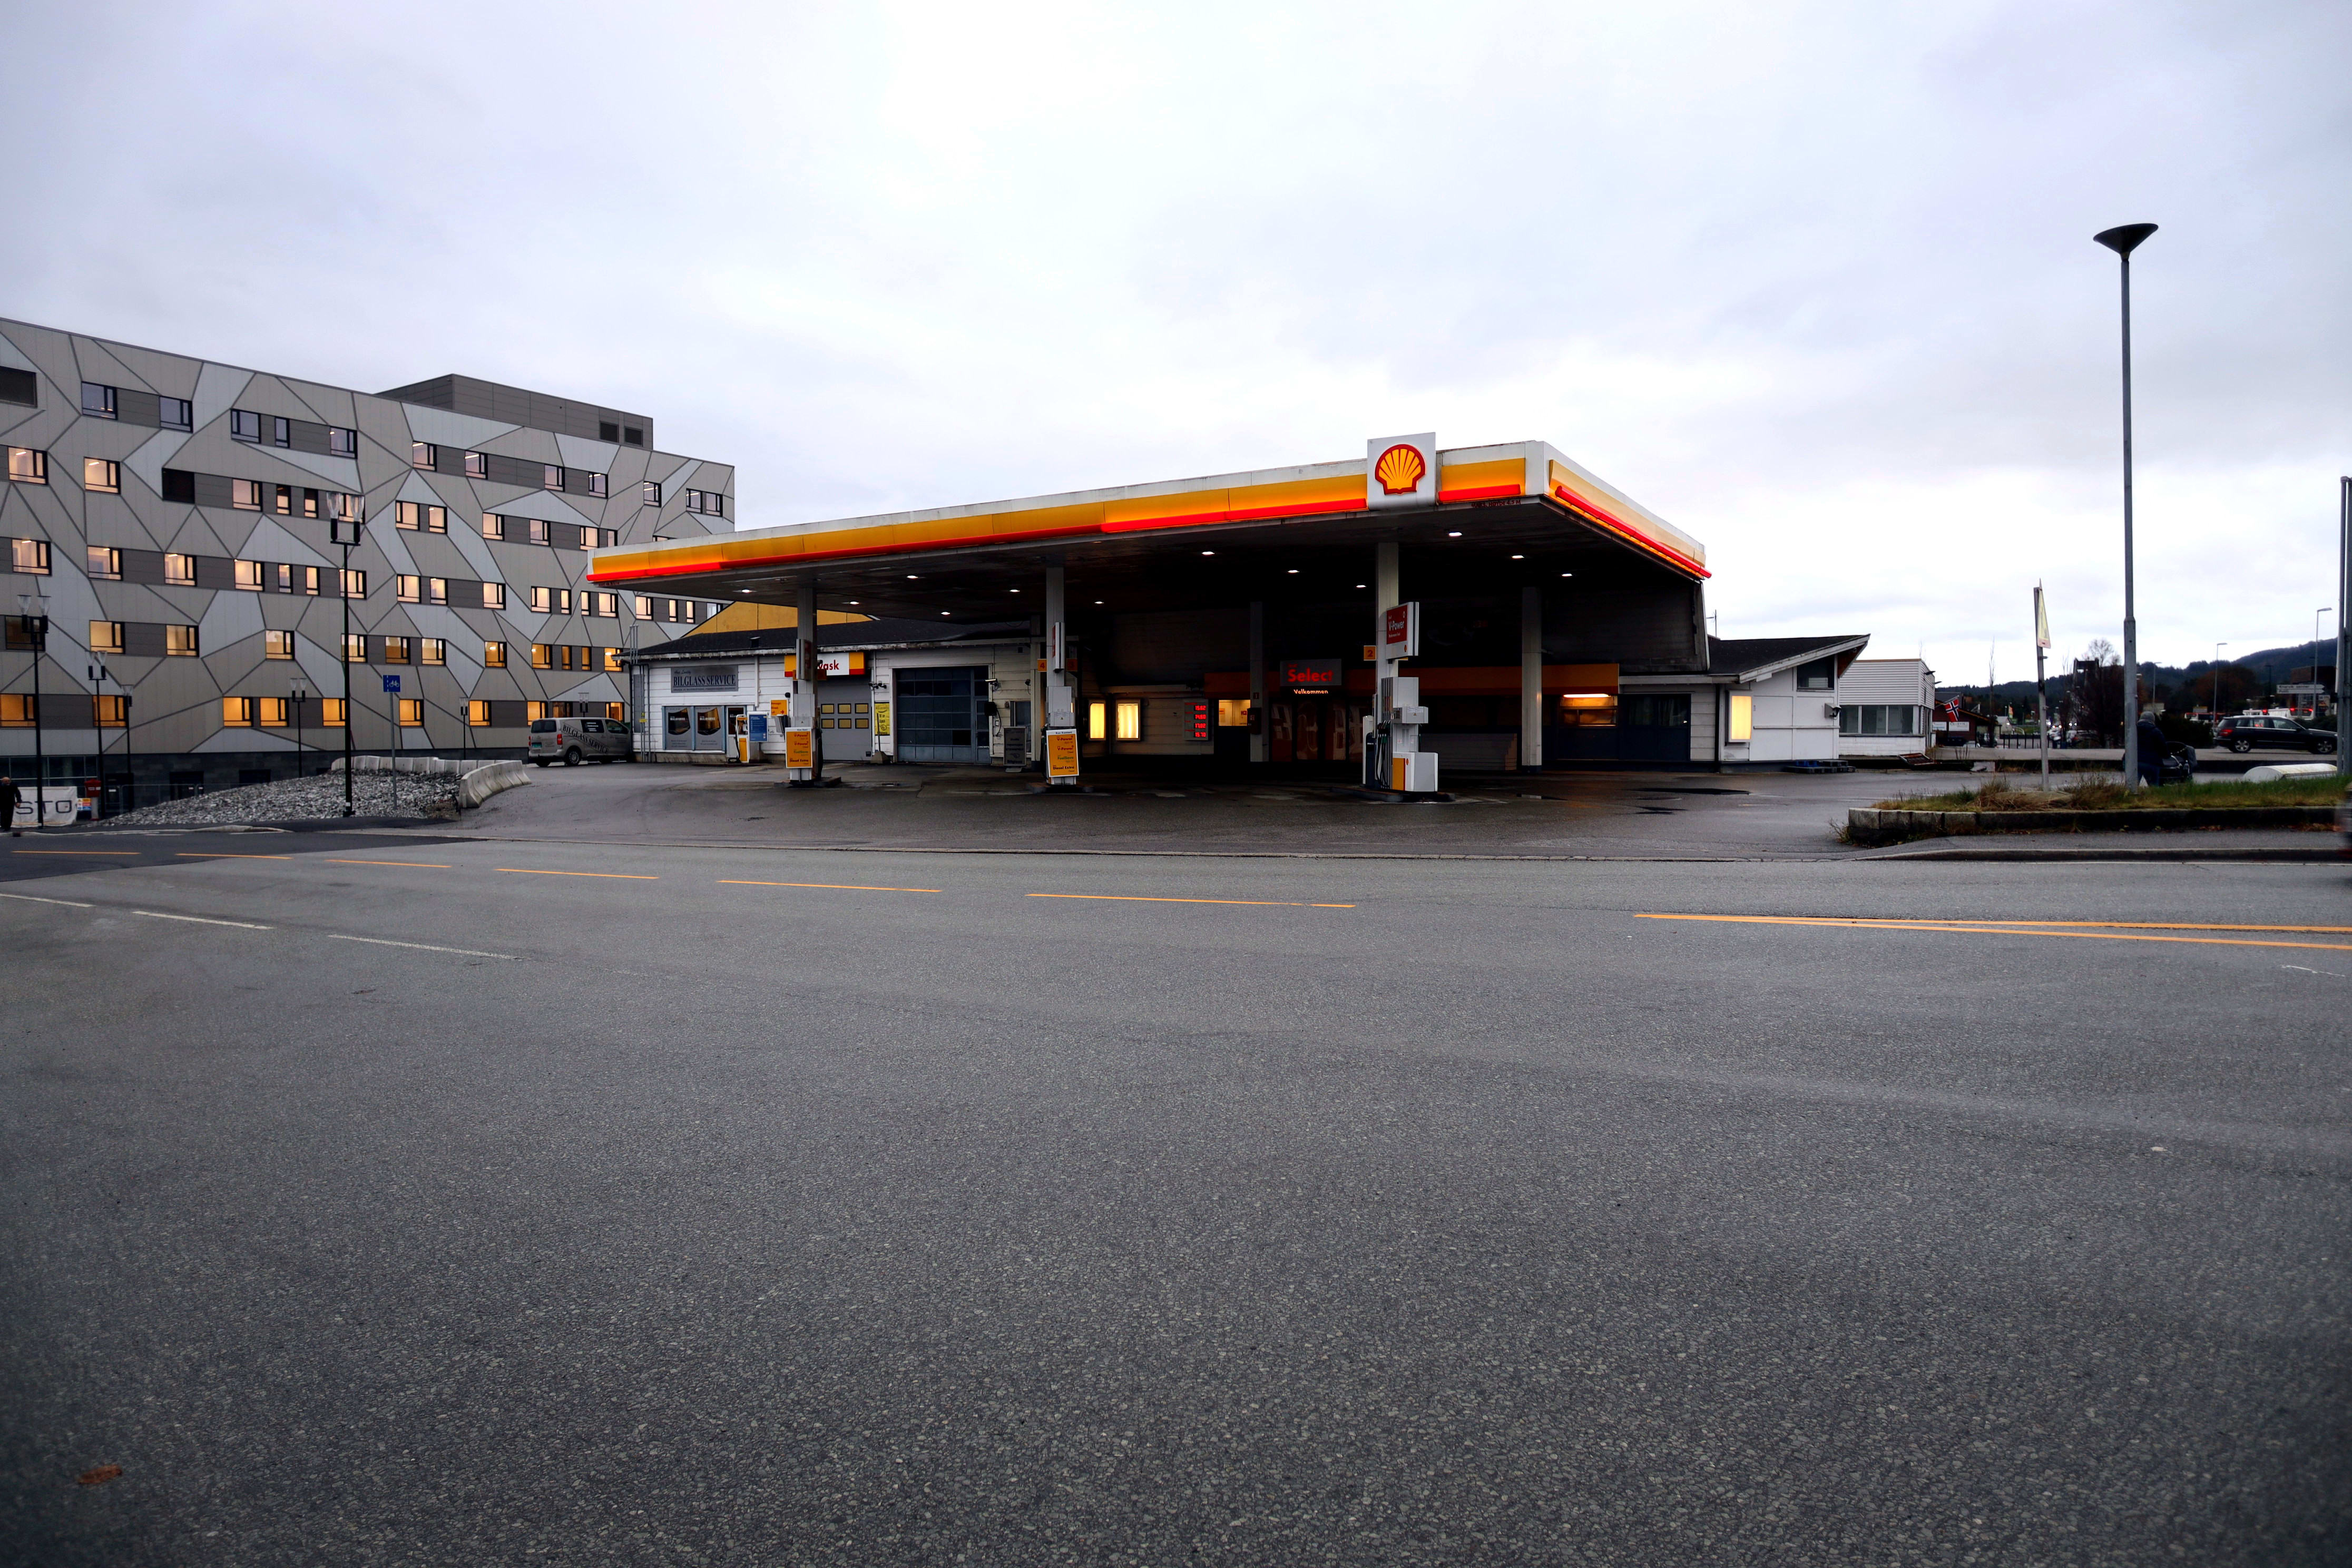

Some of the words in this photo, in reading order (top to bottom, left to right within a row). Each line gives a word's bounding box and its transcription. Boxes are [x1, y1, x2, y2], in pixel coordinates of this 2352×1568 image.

[1388, 620, 1405, 631] V-Power
[673, 675, 705, 686] BILGLASS
[706, 674, 736, 685] SERVICE
[1287, 667, 1334, 682] Select
[563, 724, 587, 743] BILGLASS
[589, 739, 608, 753] SERVICE
